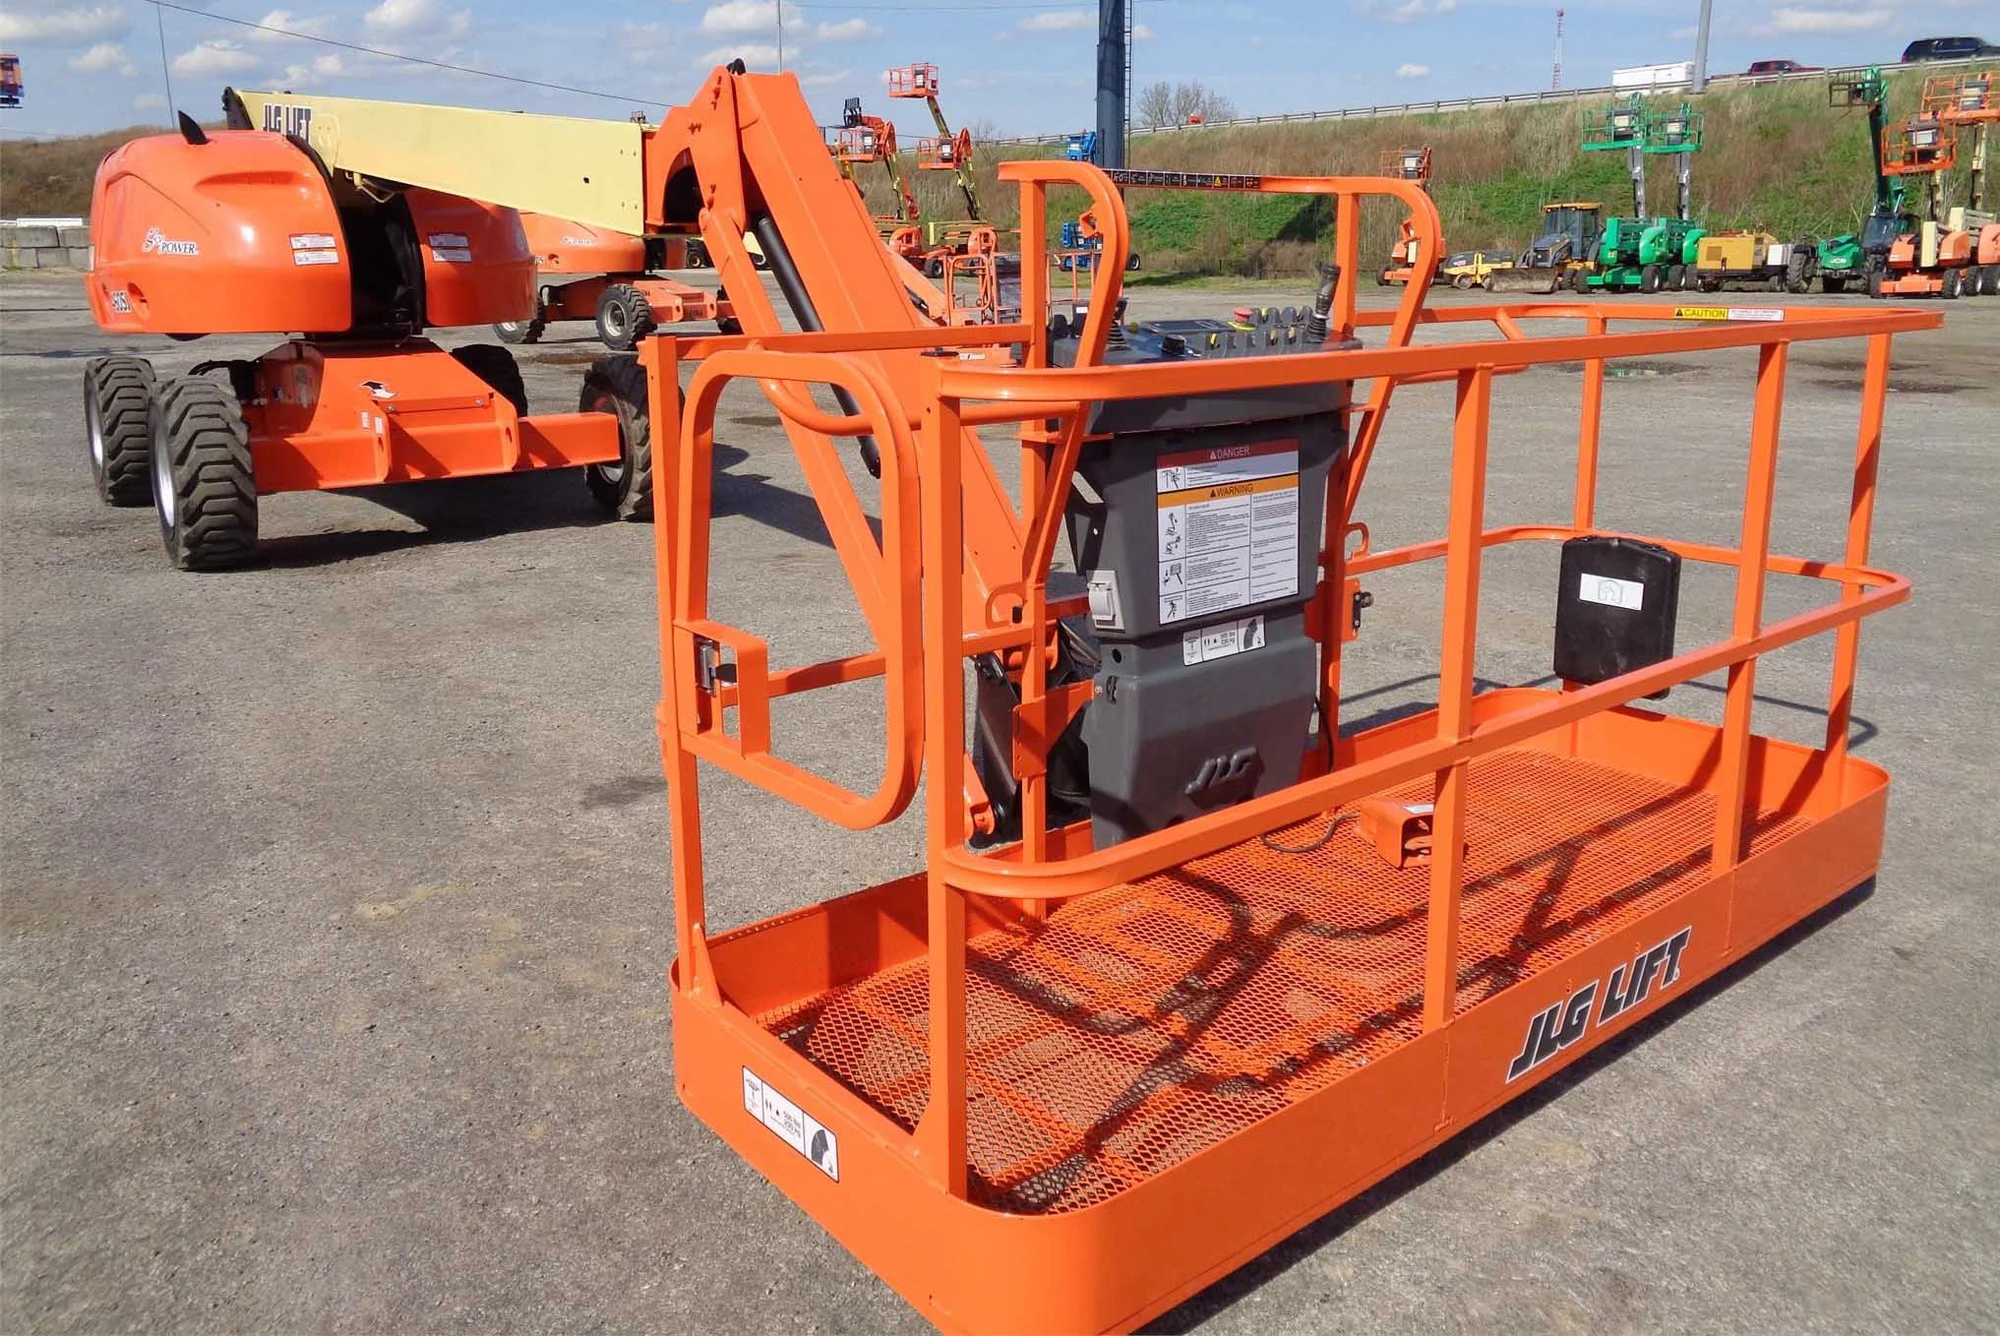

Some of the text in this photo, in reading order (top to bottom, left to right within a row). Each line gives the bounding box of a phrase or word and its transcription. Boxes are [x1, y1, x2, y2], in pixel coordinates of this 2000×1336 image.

[285, 106, 312, 144] LIFT
[161, 241, 196, 254] POWER
[1684, 309, 1726, 318] CAUTION
[1217, 446, 1251, 459] DANGER
[1217, 483, 1254, 497] WARNING
[1184, 747, 1257, 795] JLG
[1506, 925, 1692, 1084] JLG LIFT
